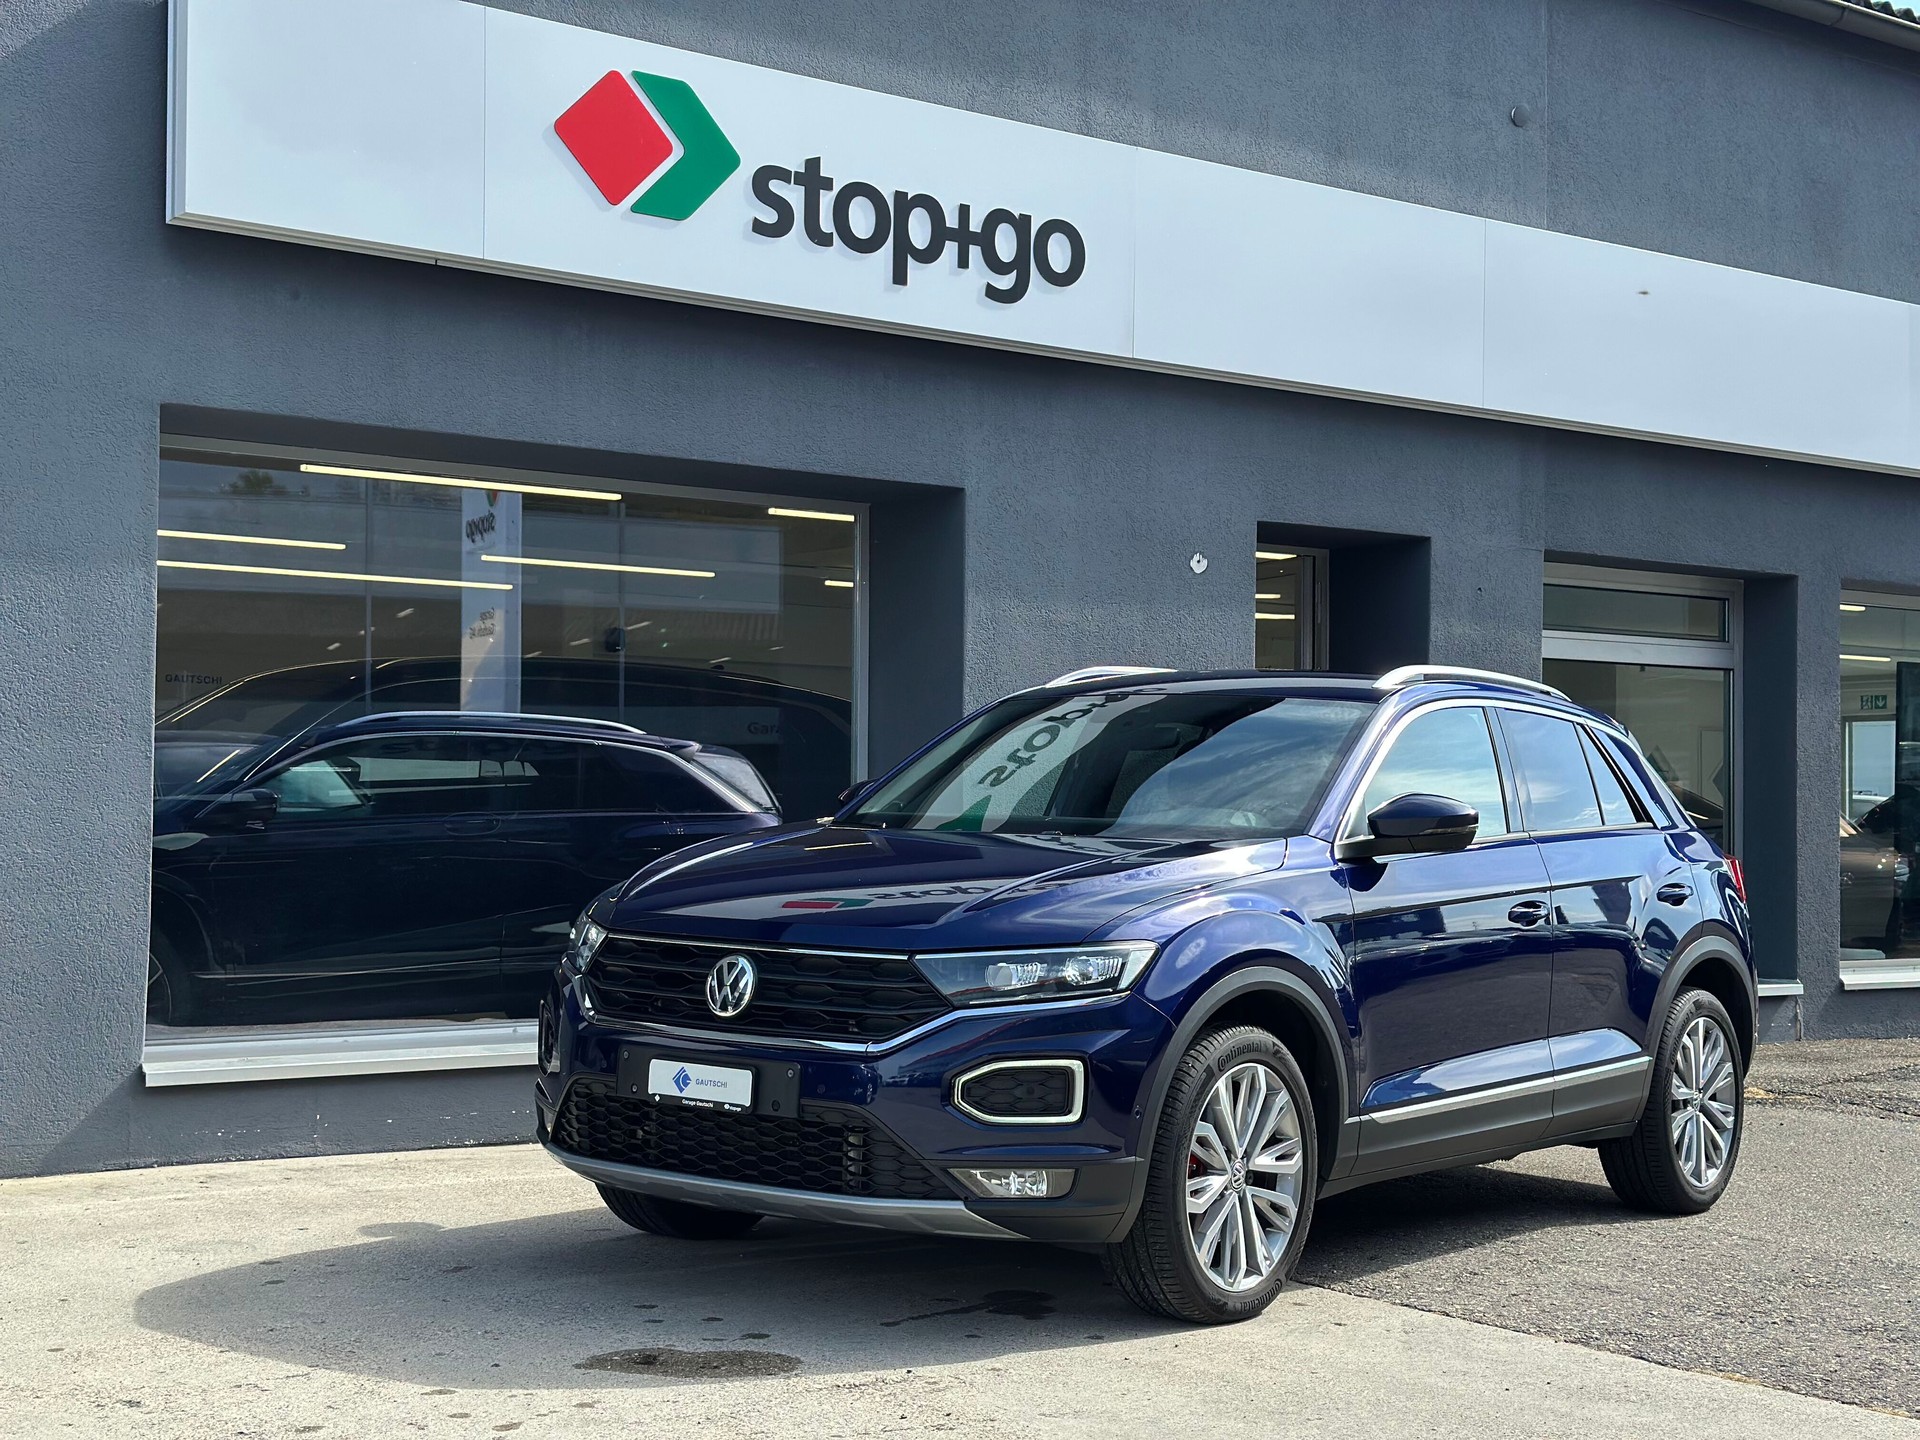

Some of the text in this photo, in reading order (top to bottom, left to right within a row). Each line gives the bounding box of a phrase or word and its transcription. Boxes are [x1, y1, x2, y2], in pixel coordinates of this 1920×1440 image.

[751, 156, 1086, 304] stop+go
[165, 674, 222, 685] GAUTSCHI
[1217, 1040, 1262, 1073] Continental
[695, 1078, 728, 1089] GAUTSCHI
